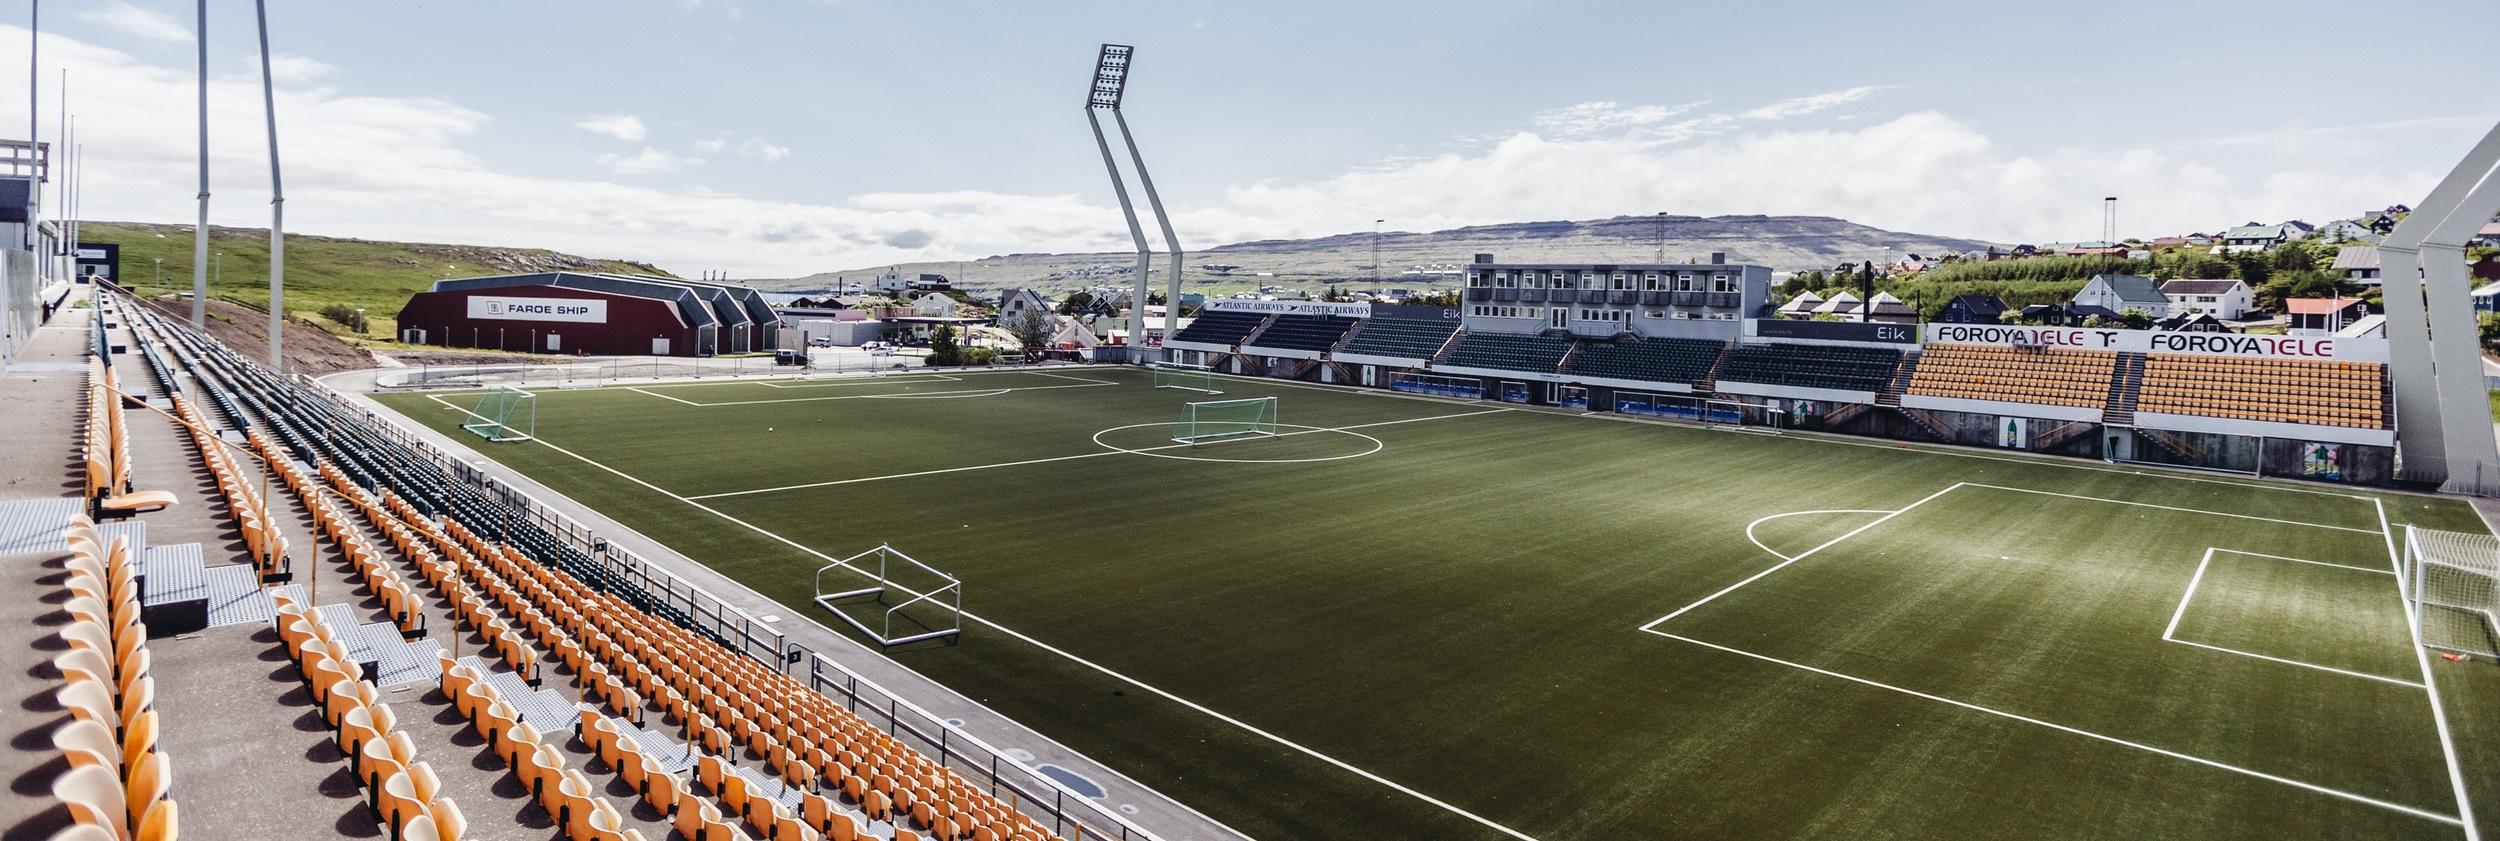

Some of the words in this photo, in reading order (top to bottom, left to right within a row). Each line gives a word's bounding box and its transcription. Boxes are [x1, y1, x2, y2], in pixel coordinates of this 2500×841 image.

[508, 304, 552, 314] FAROE
[557, 306, 588, 315] SHIP
[1222, 301, 1253, 310] ATLANTIC
[1254, 302, 1285, 311] AIRWAYS
[1299, 304, 1333, 314] ATLANTIC
[1334, 306, 1369, 315] AIRWAYS
[1443, 308, 1460, 319] Eik
[1877, 326, 1906, 340] Eik
